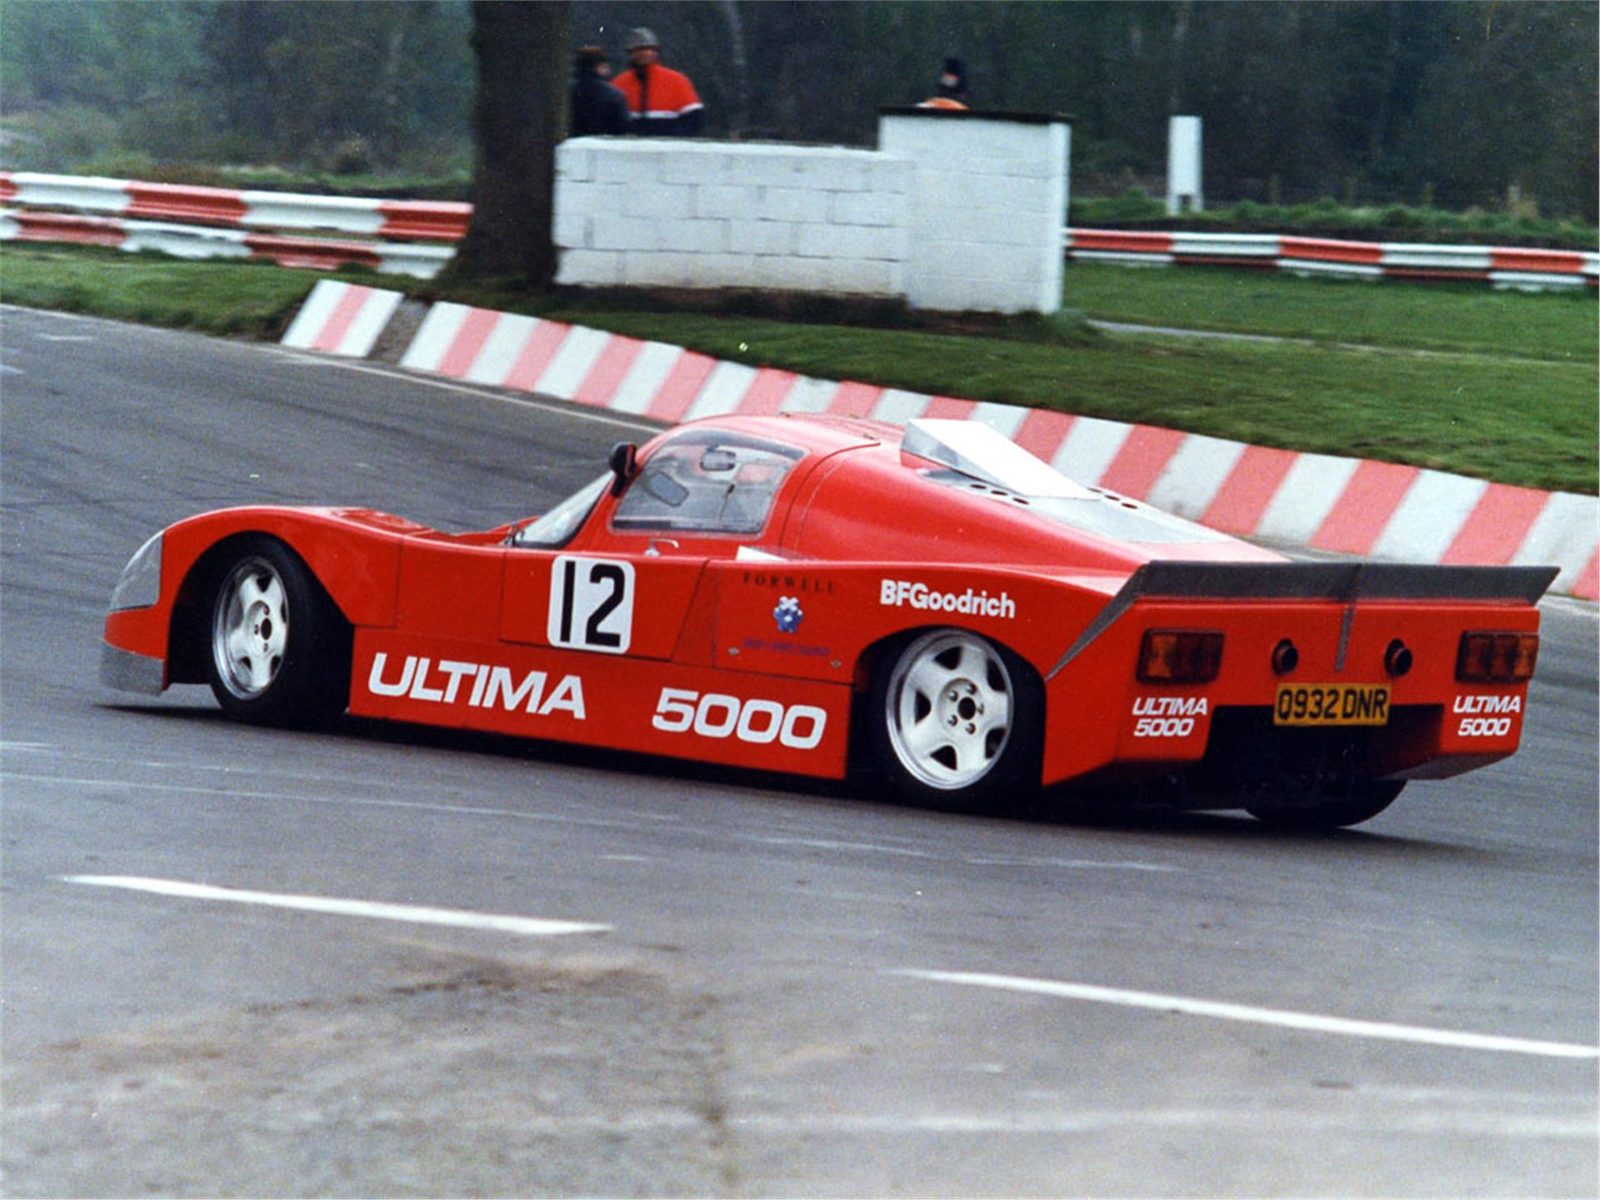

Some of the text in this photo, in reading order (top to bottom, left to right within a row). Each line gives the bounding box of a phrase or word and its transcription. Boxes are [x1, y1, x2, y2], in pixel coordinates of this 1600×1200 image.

[560, 560, 626, 648] 12
[880, 579, 1016, 619] BFGoodrich
[368, 652, 827, 750] ULTIMA 5000
[1132, 697, 1208, 716] ULTIMA
[1342, 688, 1388, 719] DNR
[1453, 695, 1521, 713] ULTIMA
[1134, 717, 1194, 737] 5000
[1458, 717, 1511, 737] 5000
